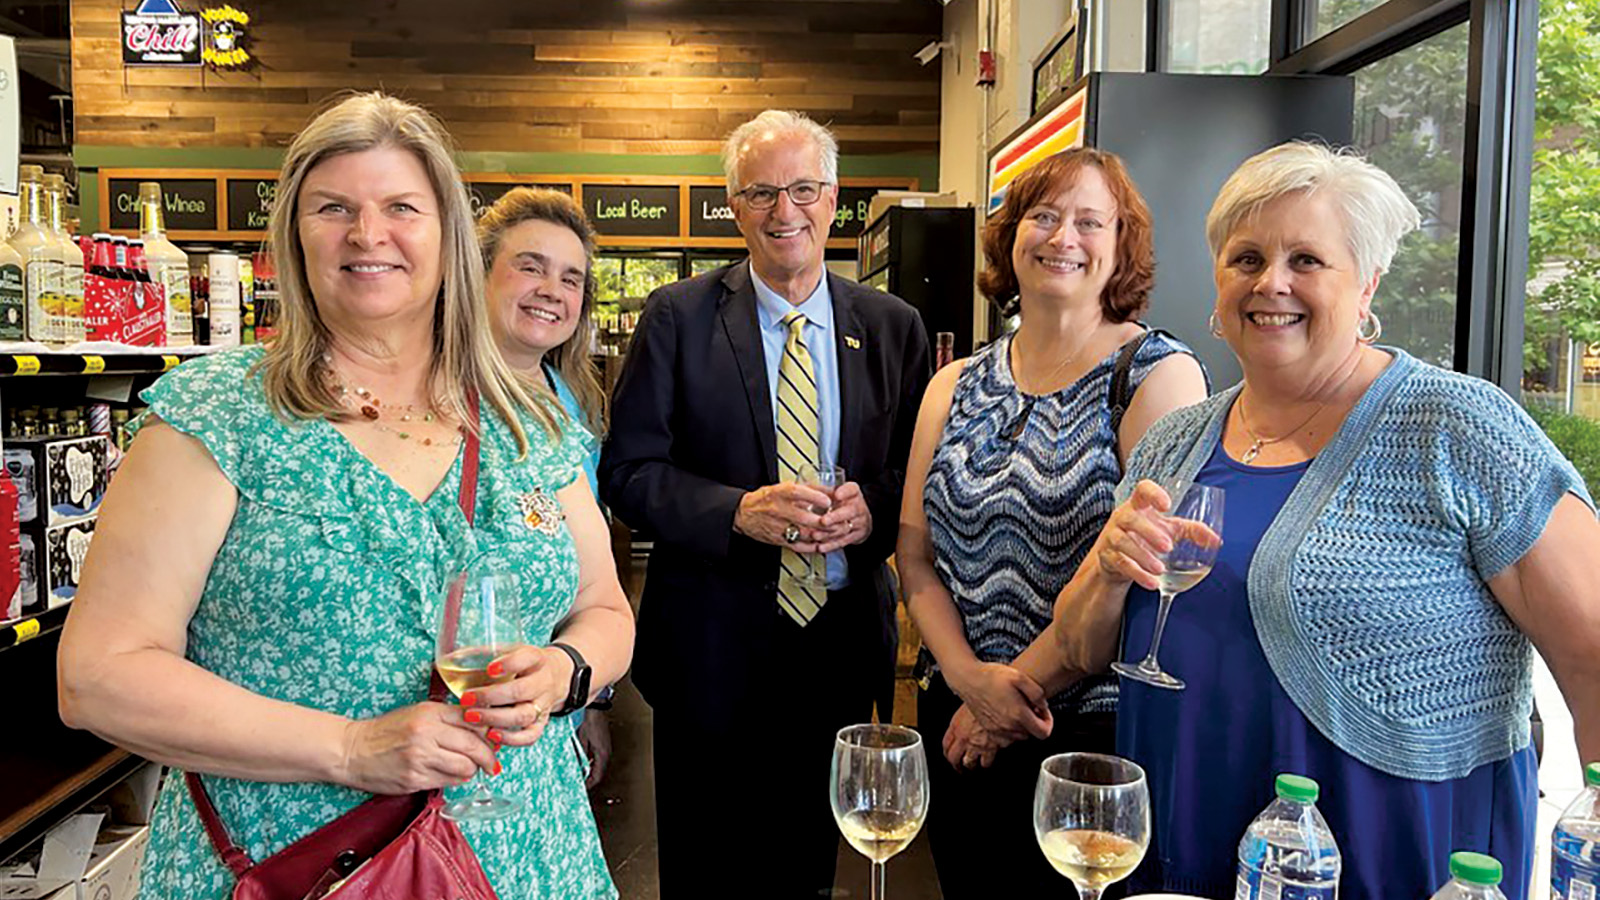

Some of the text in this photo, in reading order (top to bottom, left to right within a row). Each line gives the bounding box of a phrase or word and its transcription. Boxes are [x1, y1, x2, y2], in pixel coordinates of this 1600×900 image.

[200, 5, 249, 24] VOODOO
[125, 24, 198, 52] Chill
[164, 192, 205, 212] Wines
[597, 199, 668, 219] Local Beer
